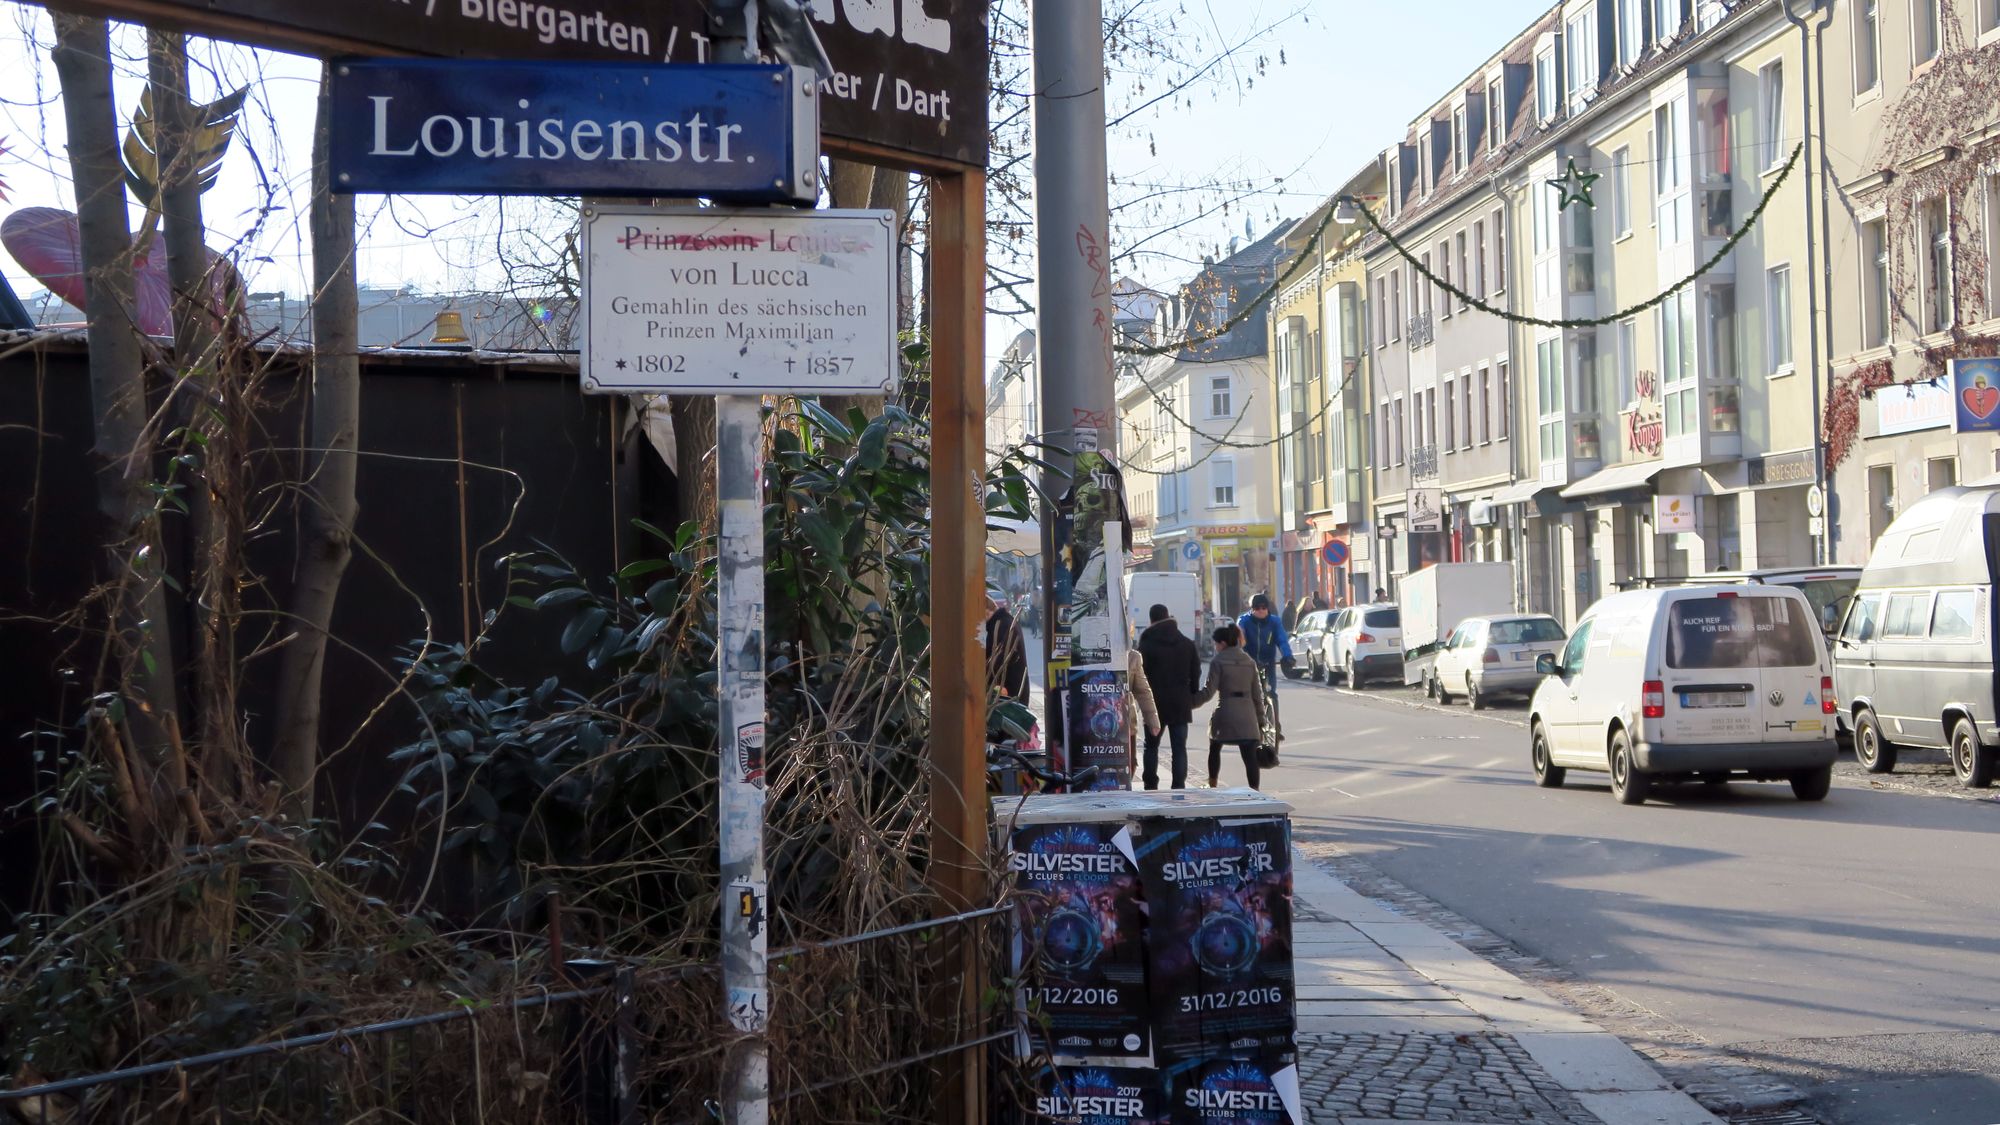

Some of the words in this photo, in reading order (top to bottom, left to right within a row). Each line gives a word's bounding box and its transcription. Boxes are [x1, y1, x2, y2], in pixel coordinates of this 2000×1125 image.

[461, 0, 650, 55] Biergarten
[895, 79, 950, 120] Dart
[367, 95, 756, 163] Louisenstr.
[624, 226, 754, 251] Prinzessin
[670, 266, 717, 285] von
[732, 262, 809, 286] Lucca
[611, 297, 709, 315] Gemahlin
[717, 299, 749, 315] des
[757, 299, 867, 316] sächsischen
[647, 321, 715, 338] Prinzen
[726, 322, 834, 343] Maximilian
[637, 355, 685, 373] 1802
[807, 357, 854, 375] 1857
[1702, 624, 1717, 632] FÜR
[1014, 852, 1126, 873] SILVESTER
[1186, 879, 1214, 888] CLUBS
[1026, 988, 1118, 1004] 1/12/2016
[1180, 987, 1281, 1012] 31/12/2016
[1117, 1087, 1141, 1096] 2017
[1185, 1088, 1286, 1111] SILVESTE
[1037, 1096, 1144, 1117] SILVESTER
[1206, 1109, 1235, 1118] CLUBS
